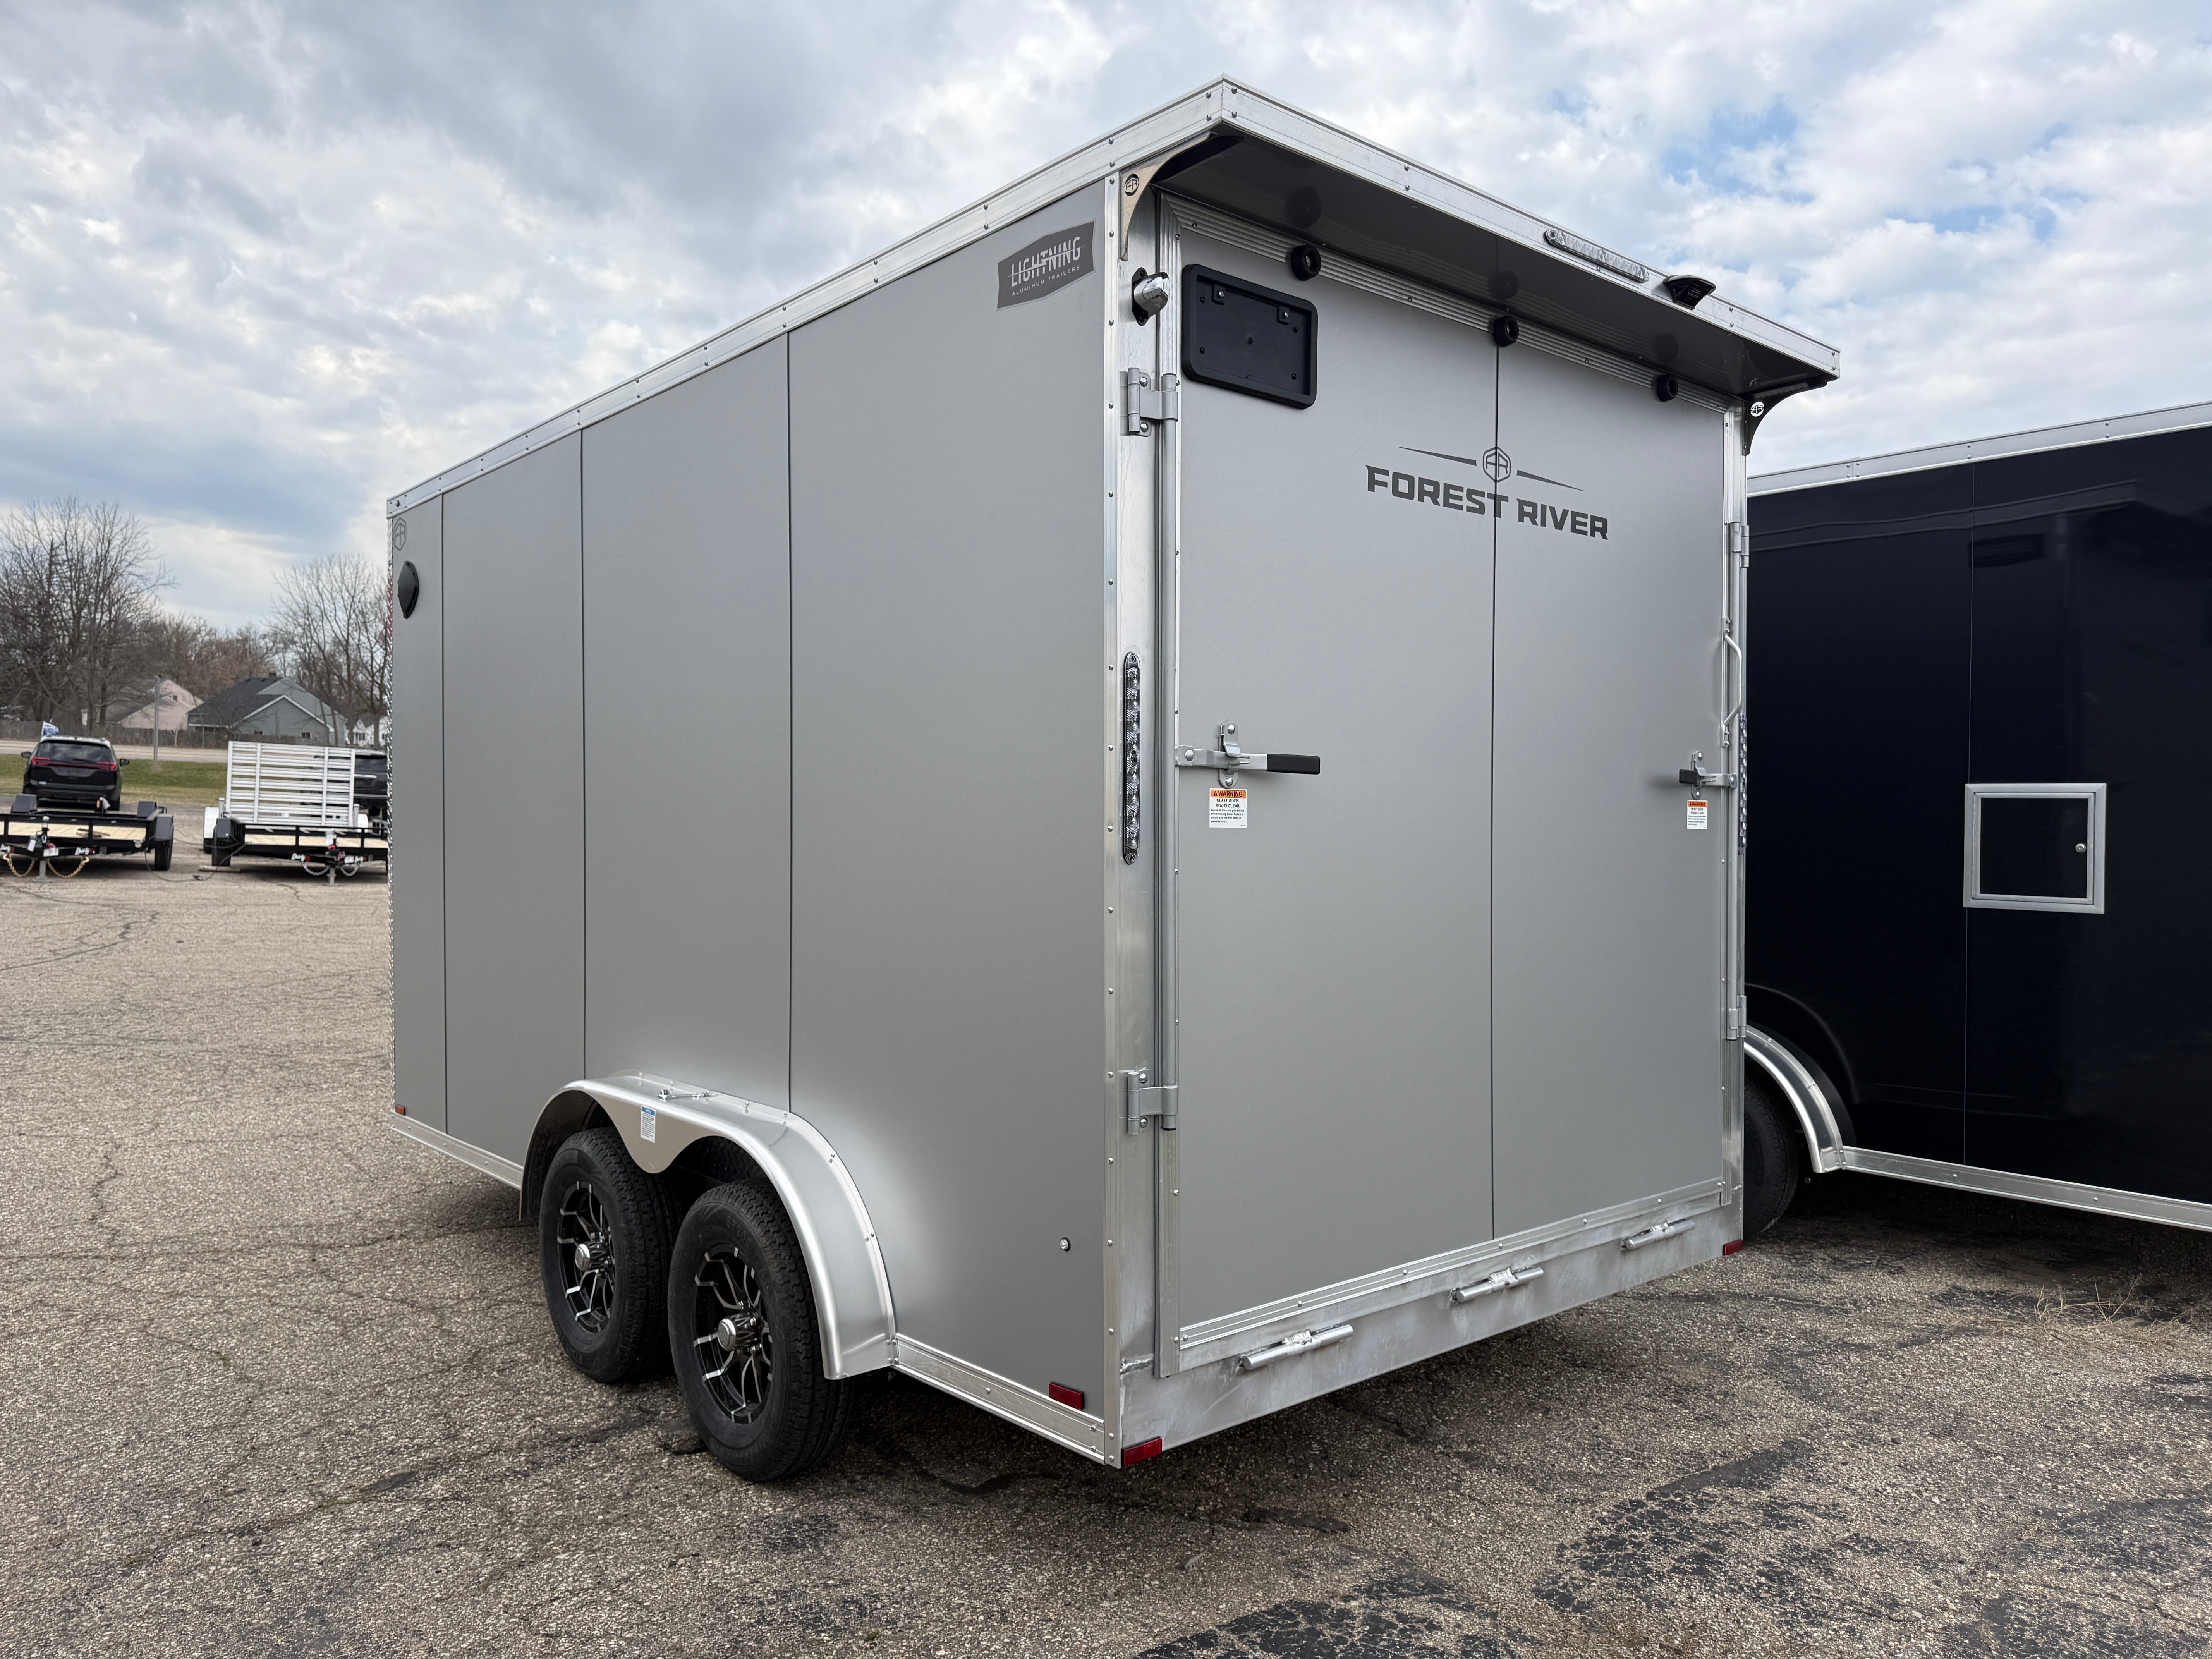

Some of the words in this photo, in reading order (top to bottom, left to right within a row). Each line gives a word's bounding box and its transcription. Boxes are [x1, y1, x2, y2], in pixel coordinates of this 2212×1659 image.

[1011, 237, 1081, 287] LIGHTNING
[1048, 265, 1080, 282] TRAILERS
[1012, 279, 1045, 297] ALUMINUM
[1365, 465, 1509, 519] FOREST
[1516, 498, 1609, 540] RIVER
